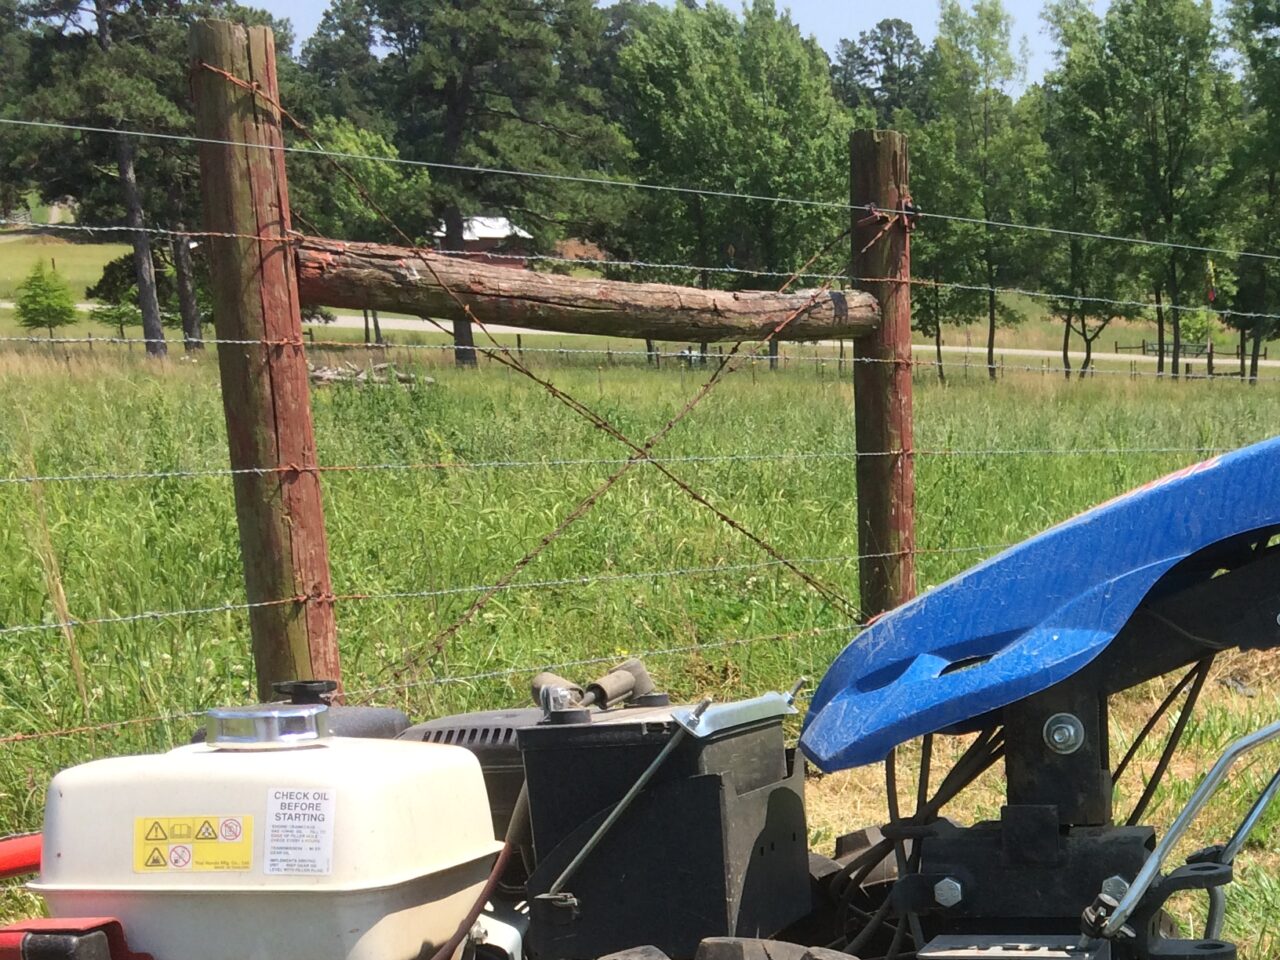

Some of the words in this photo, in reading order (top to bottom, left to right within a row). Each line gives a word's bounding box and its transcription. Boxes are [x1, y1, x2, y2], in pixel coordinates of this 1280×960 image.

[274, 791, 310, 801] CHECK
[312, 792, 329, 801] OIL
[280, 802, 322, 811] BEFORE
[274, 812, 326, 822] STARTING
